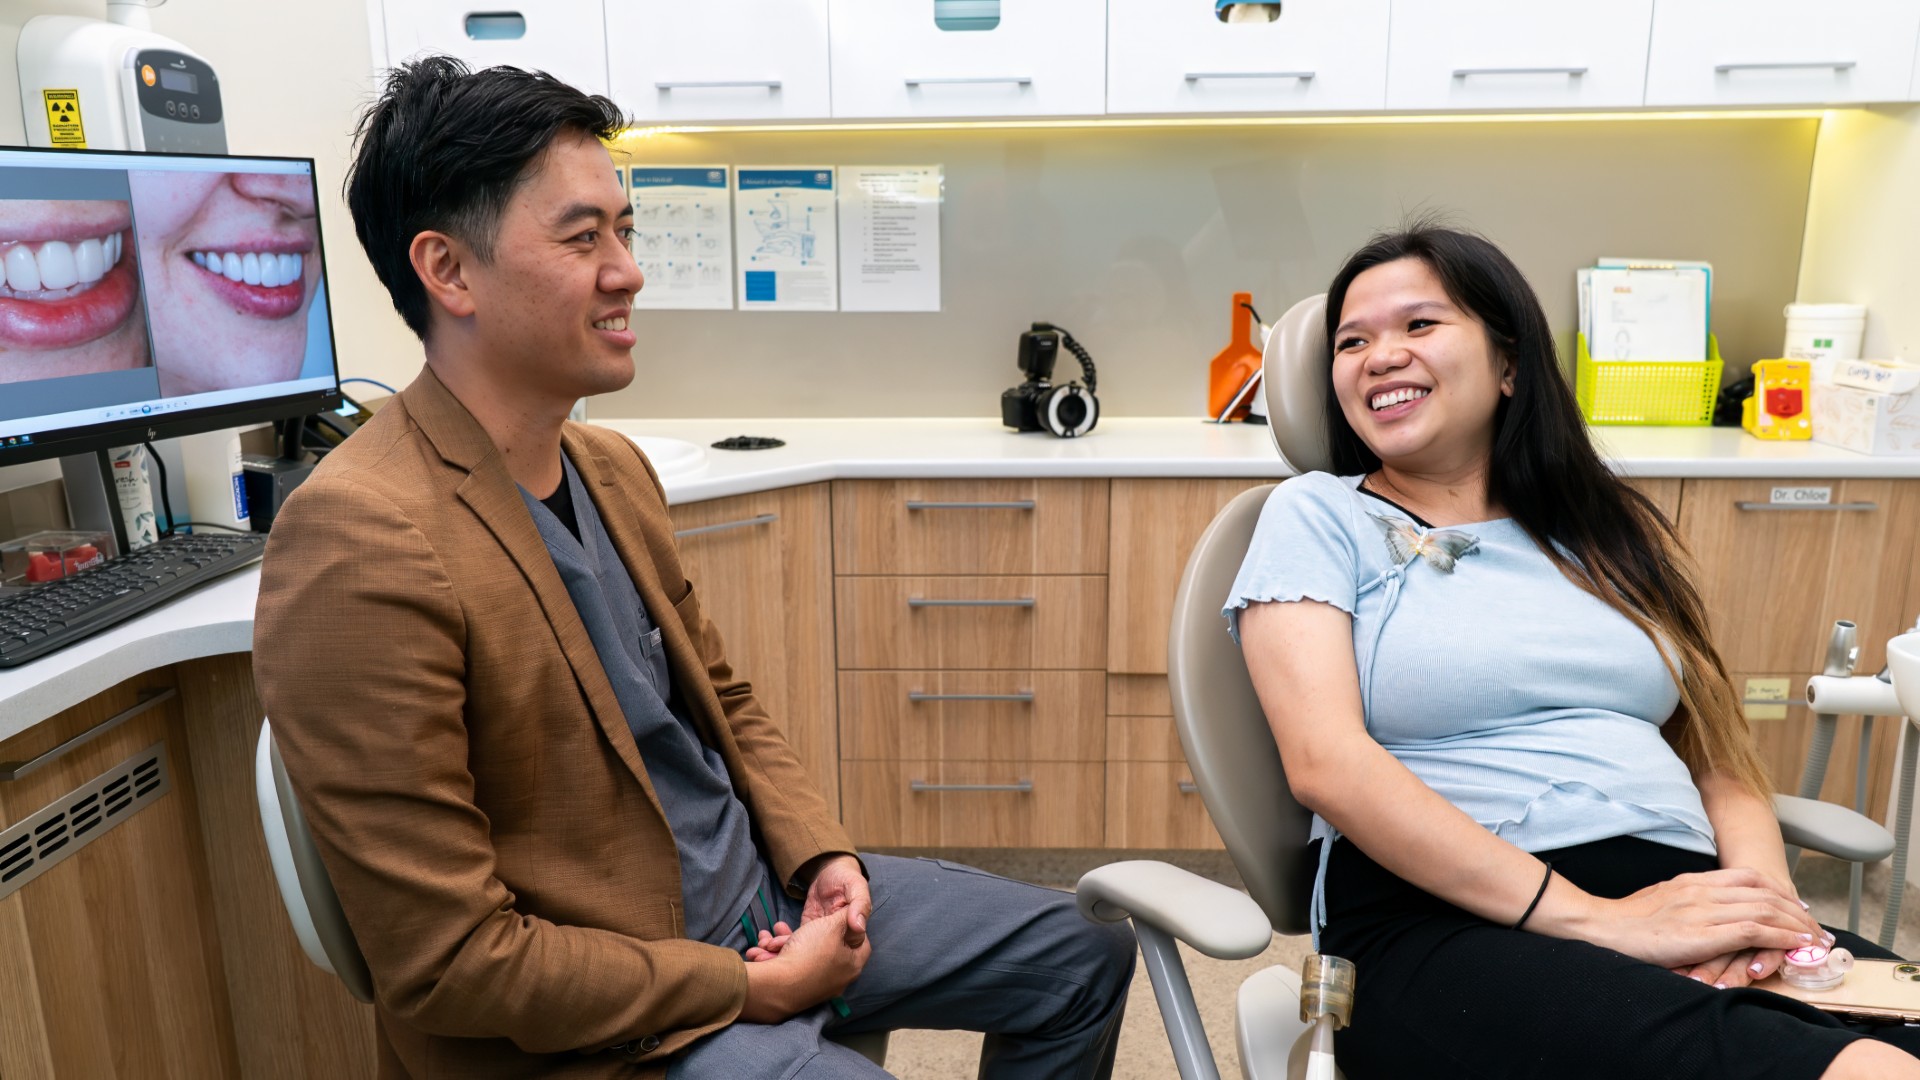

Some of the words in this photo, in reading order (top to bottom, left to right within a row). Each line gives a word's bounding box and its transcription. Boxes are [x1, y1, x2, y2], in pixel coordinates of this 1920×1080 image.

[115, 471, 138, 485] resh
[1774, 489, 1790, 501] Dr.
[1793, 489, 1828, 501] Chloe
